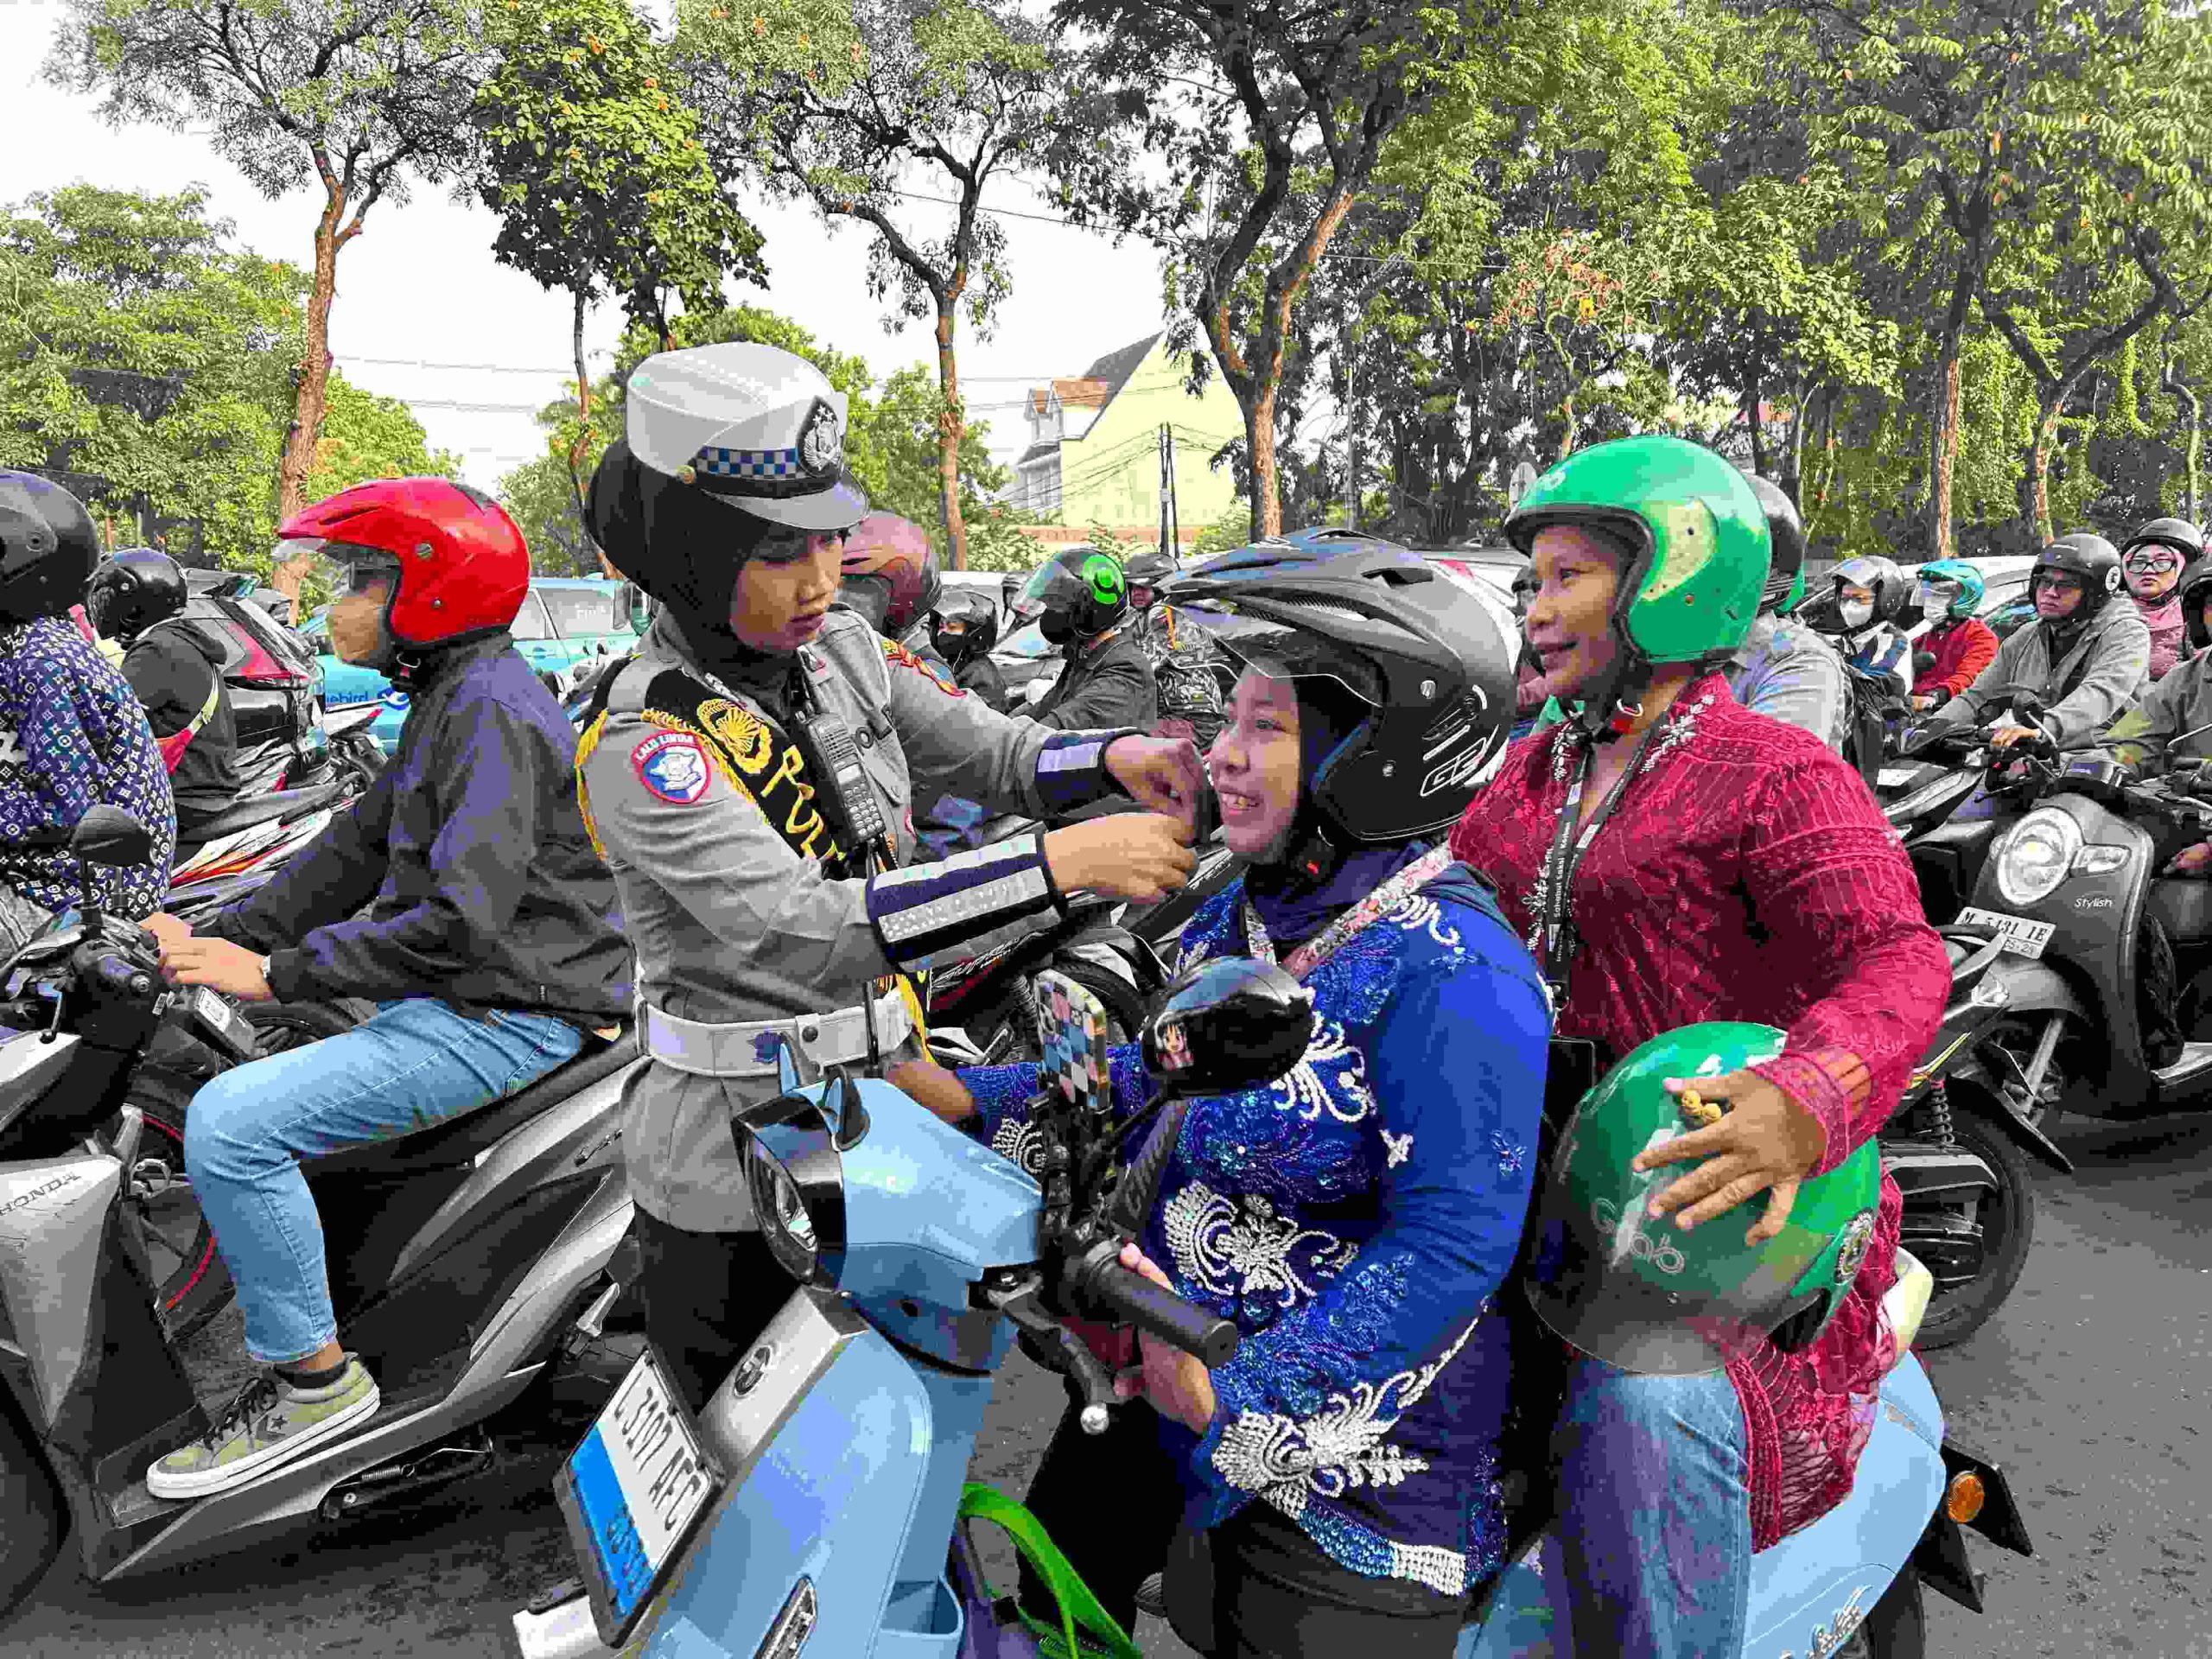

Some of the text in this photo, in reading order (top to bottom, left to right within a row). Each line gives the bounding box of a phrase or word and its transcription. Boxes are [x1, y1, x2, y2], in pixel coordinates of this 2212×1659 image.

[2075, 897, 2113, 910] Stylish
[1961, 912, 1976, 925] M
[0, 1173, 82, 1217] HONDA
[614, 1369, 645, 1421] L
[648, 1445, 702, 1532] AFC
